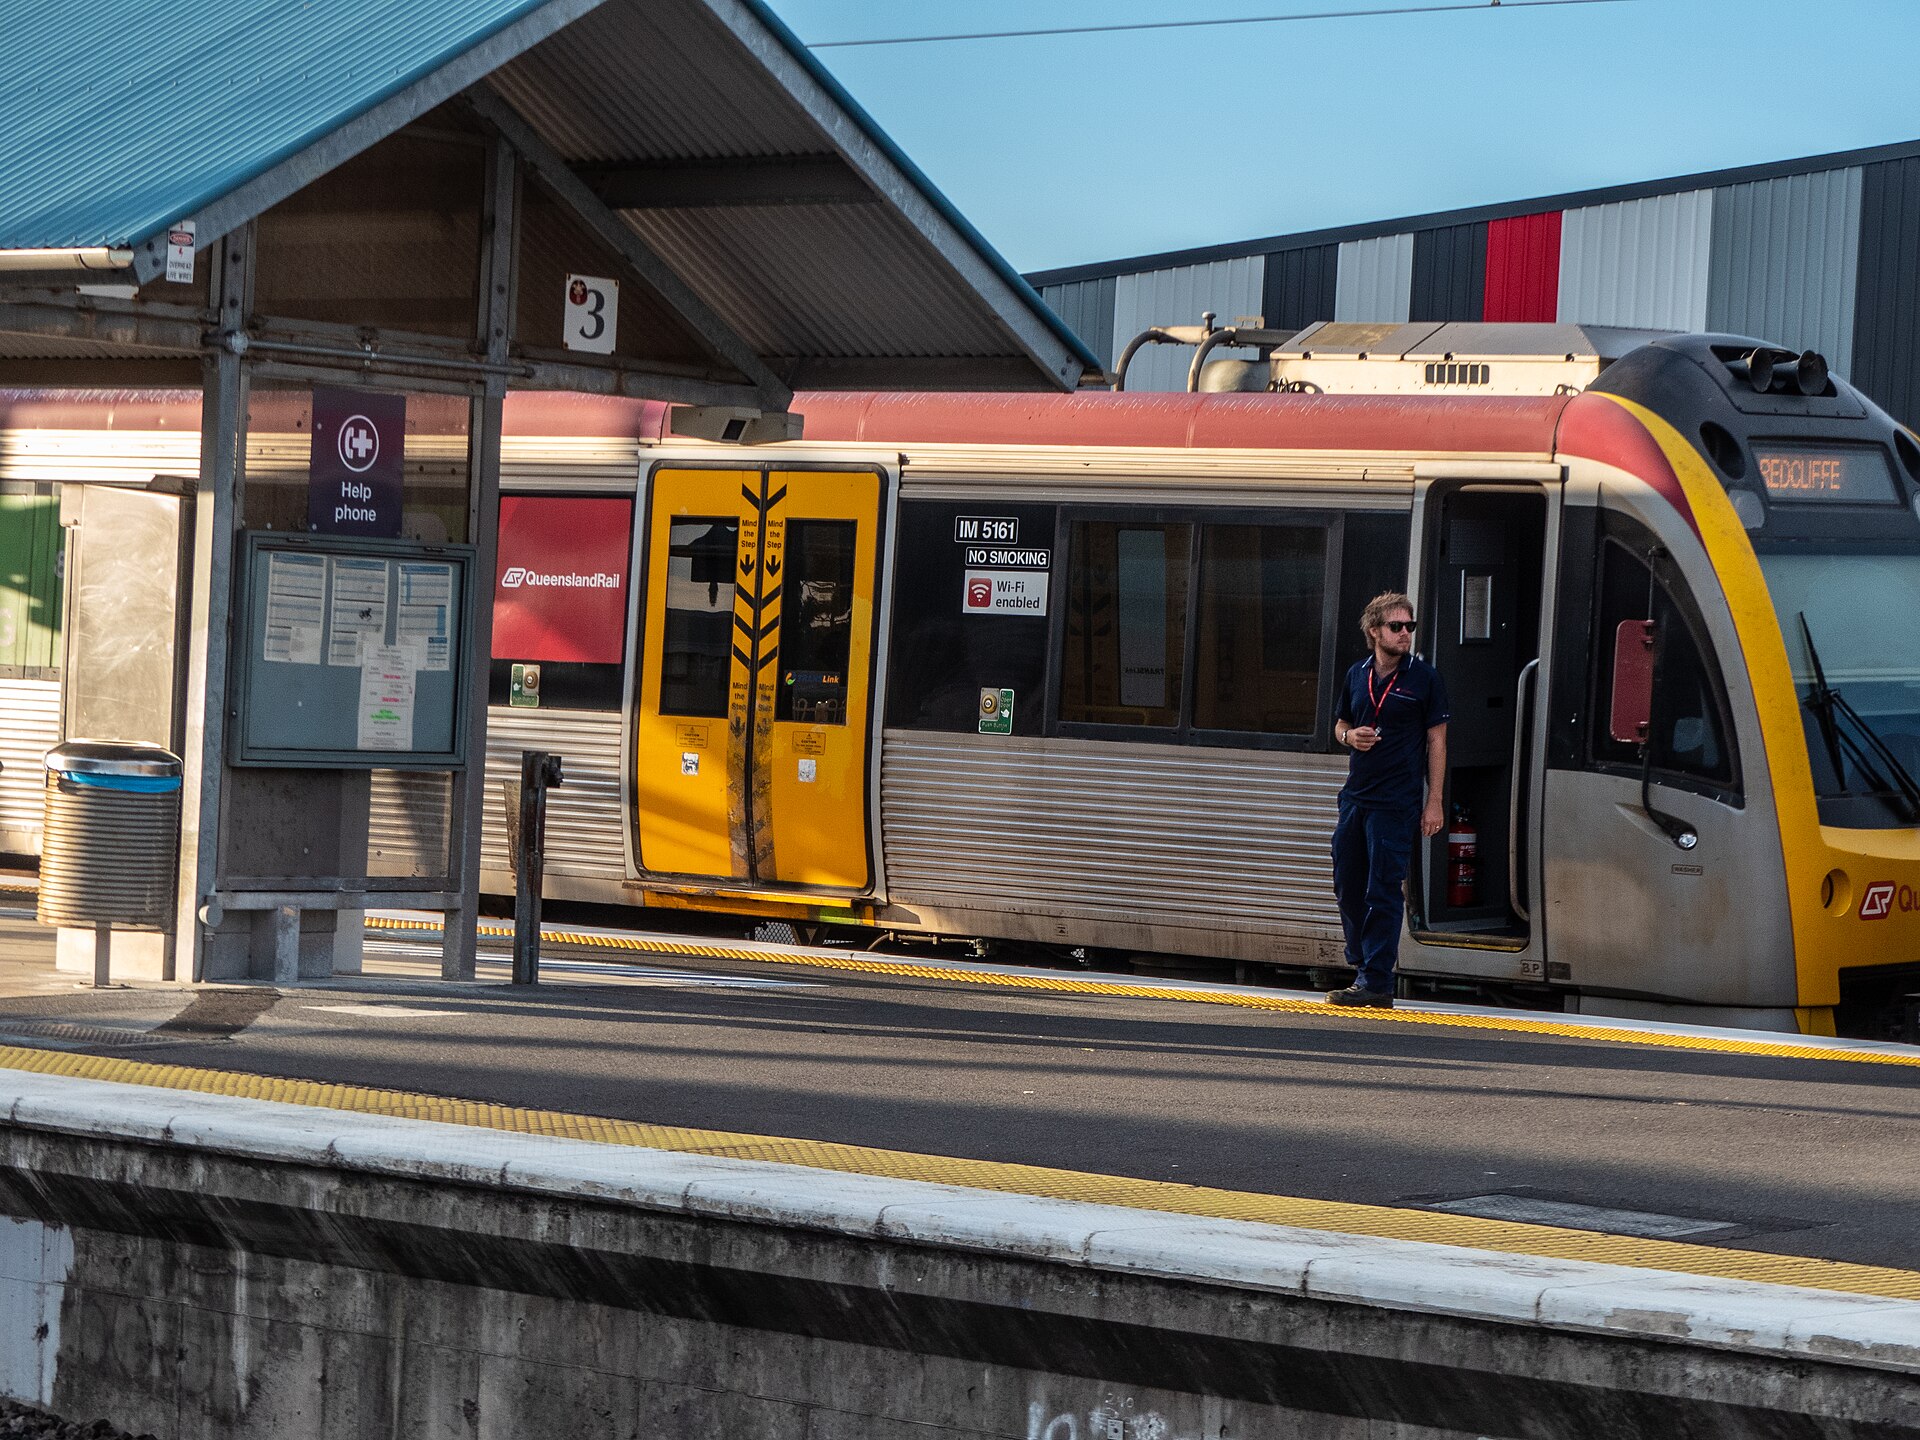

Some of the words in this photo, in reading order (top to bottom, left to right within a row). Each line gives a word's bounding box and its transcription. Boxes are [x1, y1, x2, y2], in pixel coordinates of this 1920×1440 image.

[579, 289, 605, 339] 3
[341, 481, 372, 502] Help
[335, 504, 377, 523] phone
[741, 519, 757, 527] Mind
[767, 520, 784, 528] Mind
[743, 530, 755, 538] the
[959, 520, 979, 538] IM
[982, 521, 1015, 540] 5161
[741, 540, 756, 549] Step
[766, 541, 782, 550] Step
[968, 550, 987, 563] NO
[989, 551, 1047, 565] SMOKING
[526, 571, 620, 588] QueenslandRail
[997, 580, 1025, 593] Wi-Fi
[995, 597, 1040, 609] enabled
[732, 682, 748, 690] Mind
[758, 683, 774, 691] Mind
